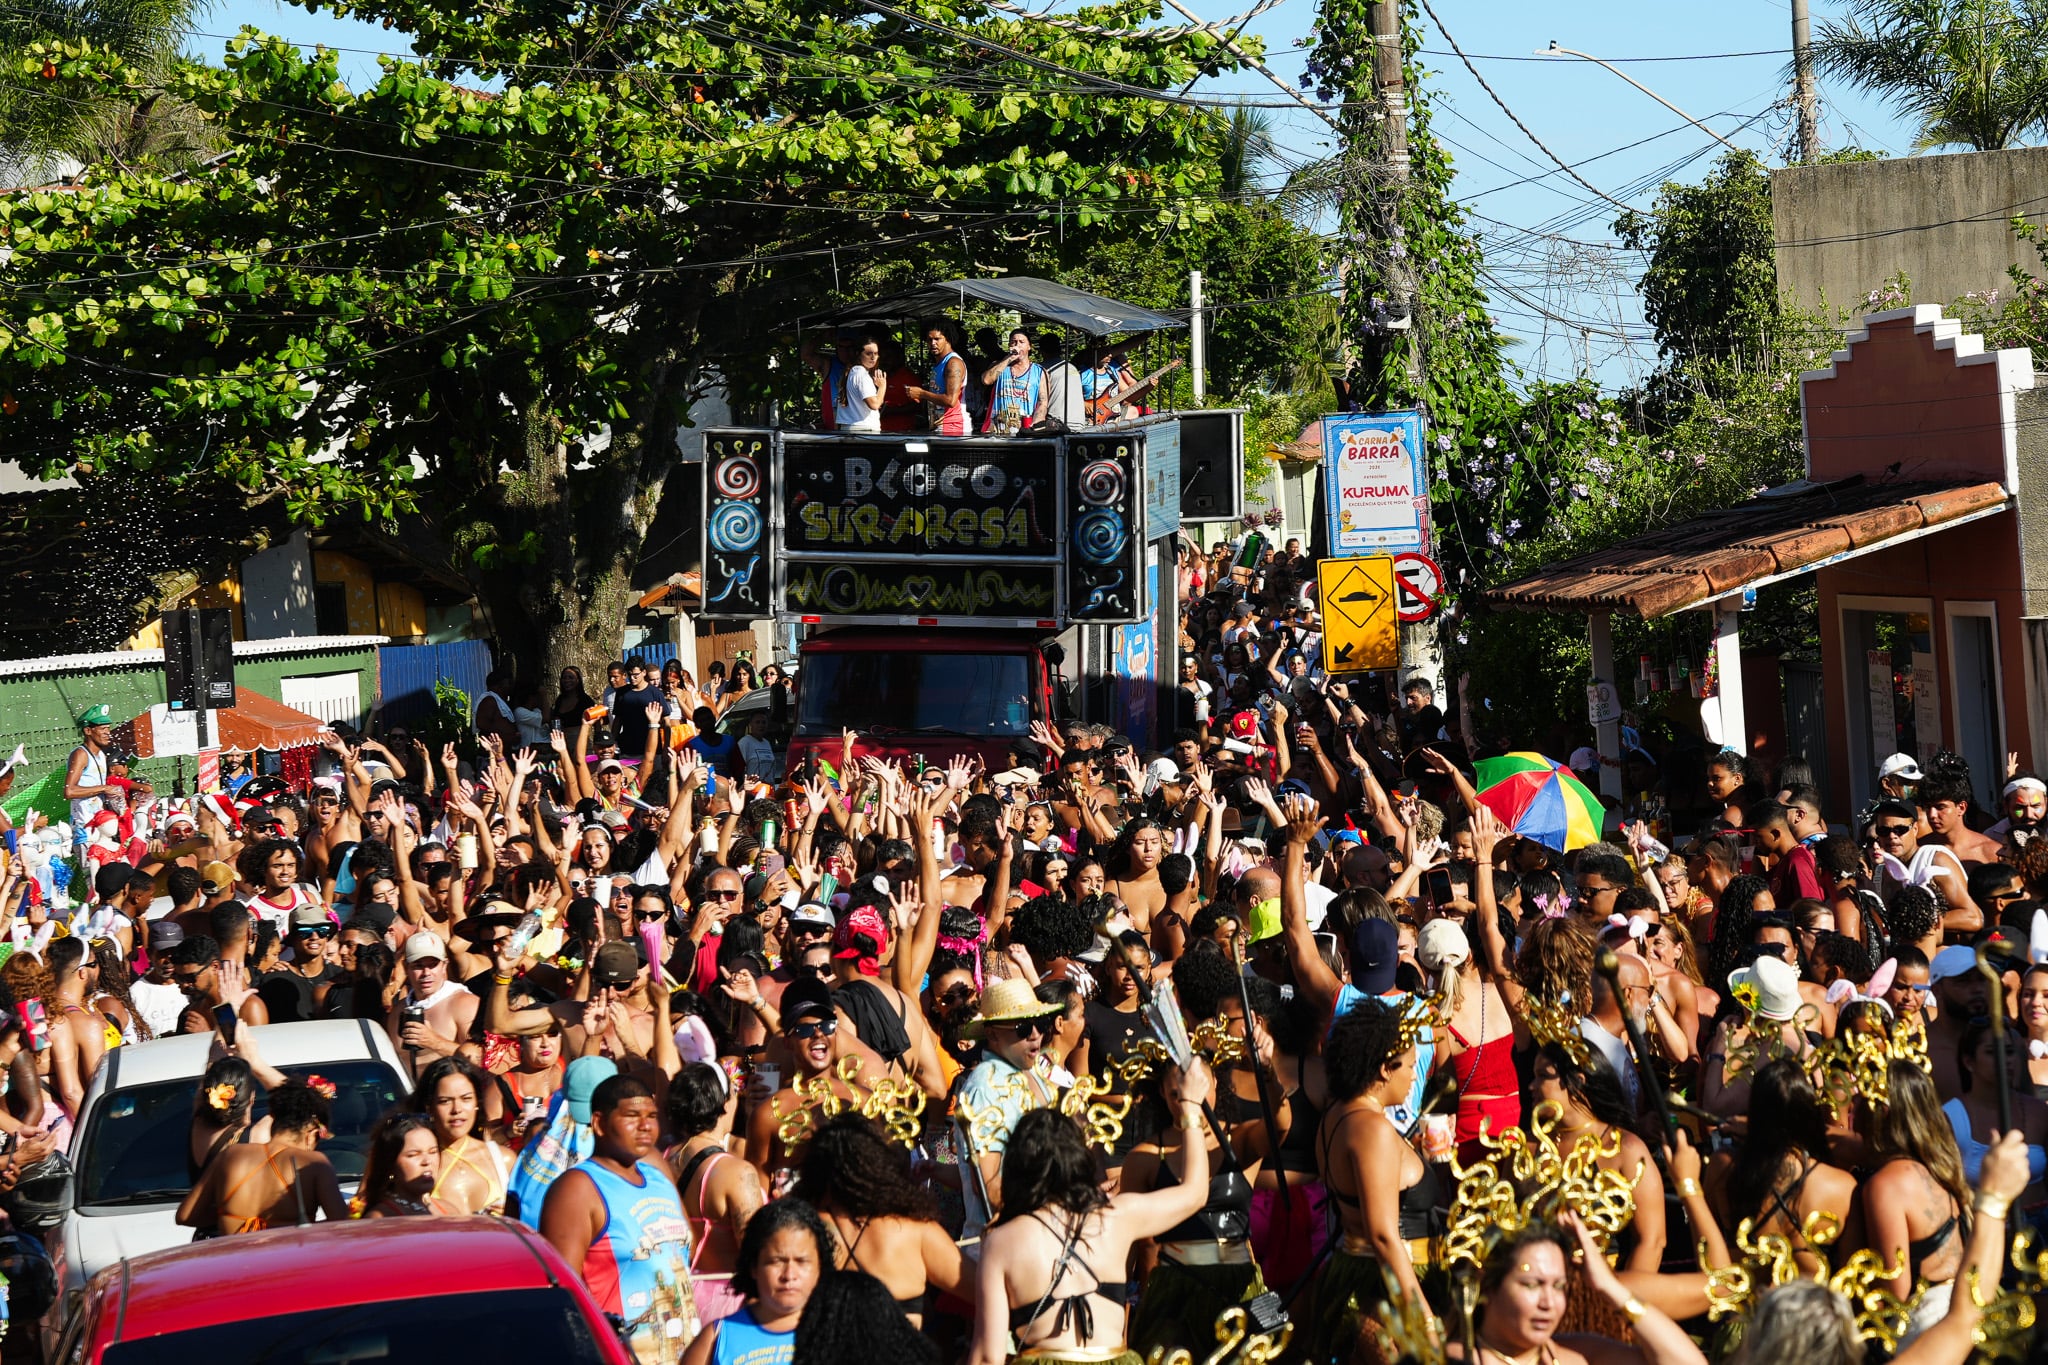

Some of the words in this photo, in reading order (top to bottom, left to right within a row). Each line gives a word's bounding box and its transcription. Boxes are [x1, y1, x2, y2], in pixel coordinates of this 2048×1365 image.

[1348, 445, 1399, 460] BARRA
[1358, 436, 1388, 446] CARNA
[844, 457, 1007, 500] BLOCO
[1397, 568, 1424, 608] E
